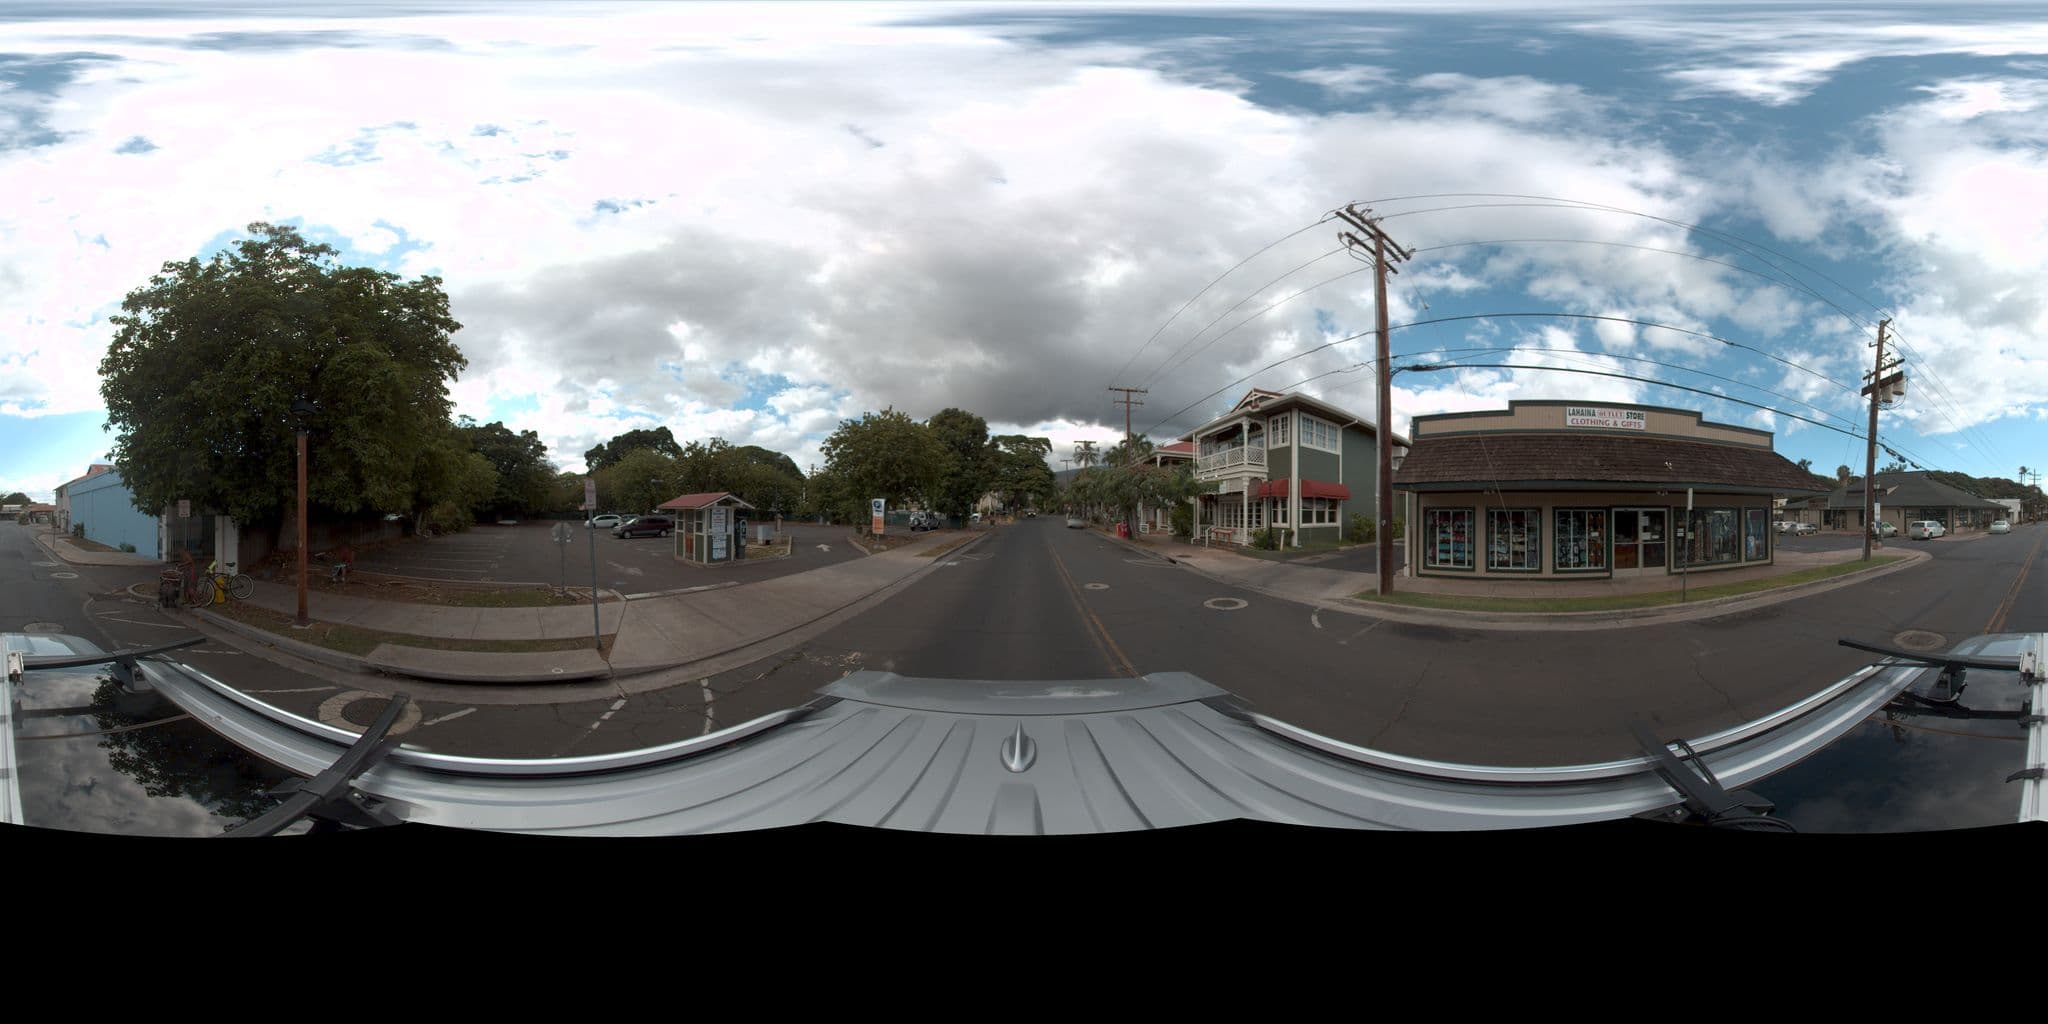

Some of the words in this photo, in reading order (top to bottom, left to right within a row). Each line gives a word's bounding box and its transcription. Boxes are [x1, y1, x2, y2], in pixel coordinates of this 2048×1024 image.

[1568, 408, 1596, 416] LAHAINA
[1626, 411, 1644, 420] STORE
[1571, 418, 1610, 426] CLOTHING
[1621, 420, 1642, 428] GIFTS
